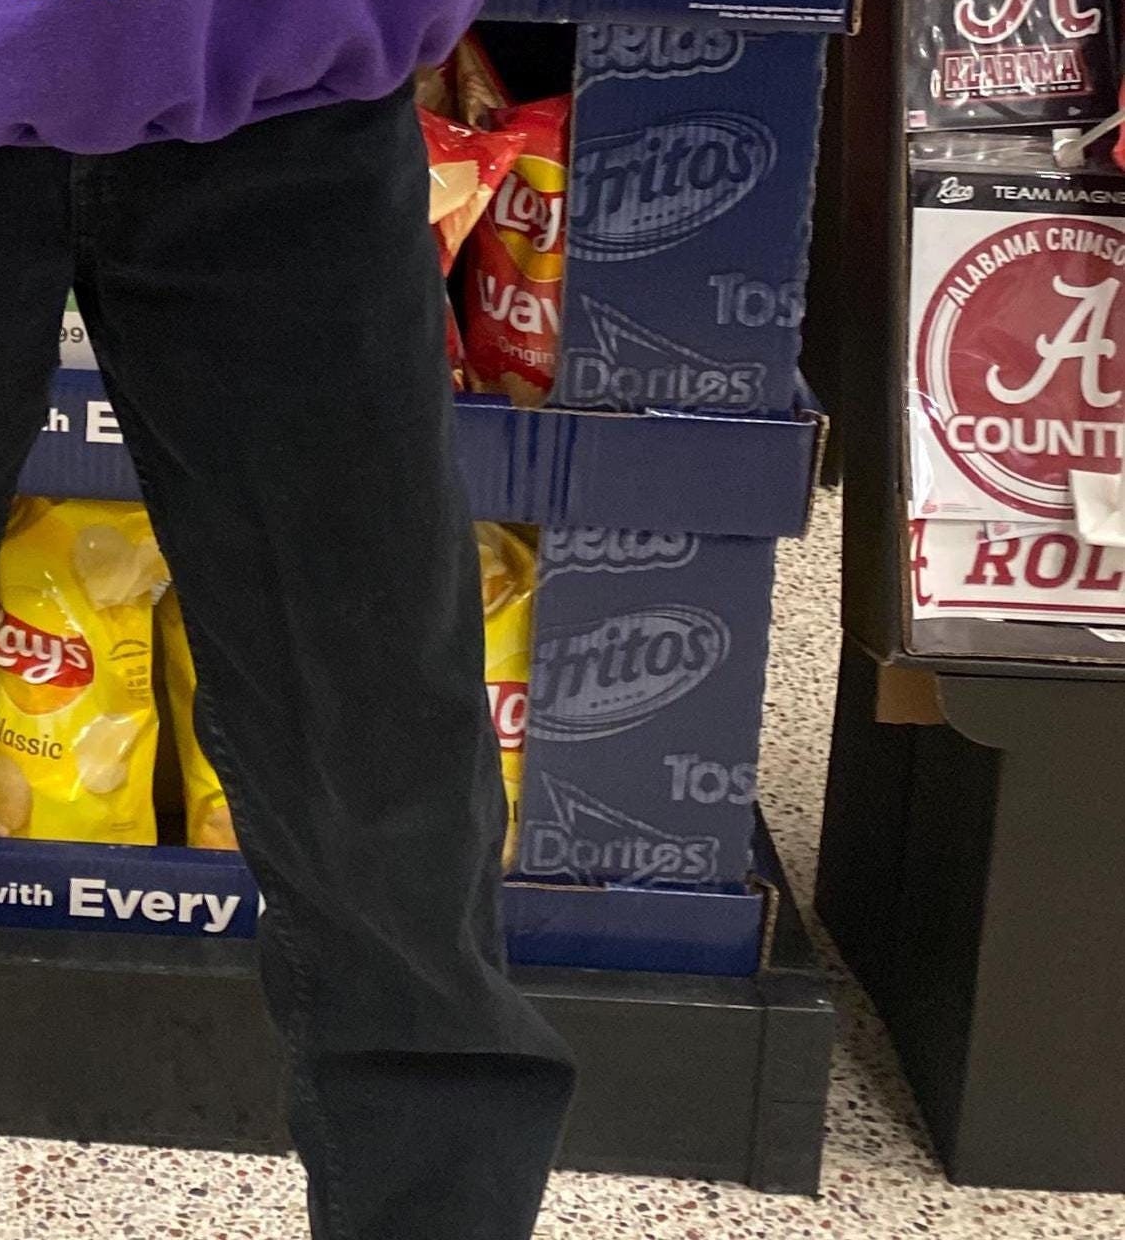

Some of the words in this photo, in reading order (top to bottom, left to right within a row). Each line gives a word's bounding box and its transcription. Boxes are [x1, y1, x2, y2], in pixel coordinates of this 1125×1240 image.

[992, 185, 1051, 201] TEAM
[946, 230, 1042, 307] ALABAMA
[576, 360, 754, 402] Doritos
[963, 531, 1123, 591] ROL
[531, 828, 709, 875] Doritos
[69, 877, 241, 933] Every
